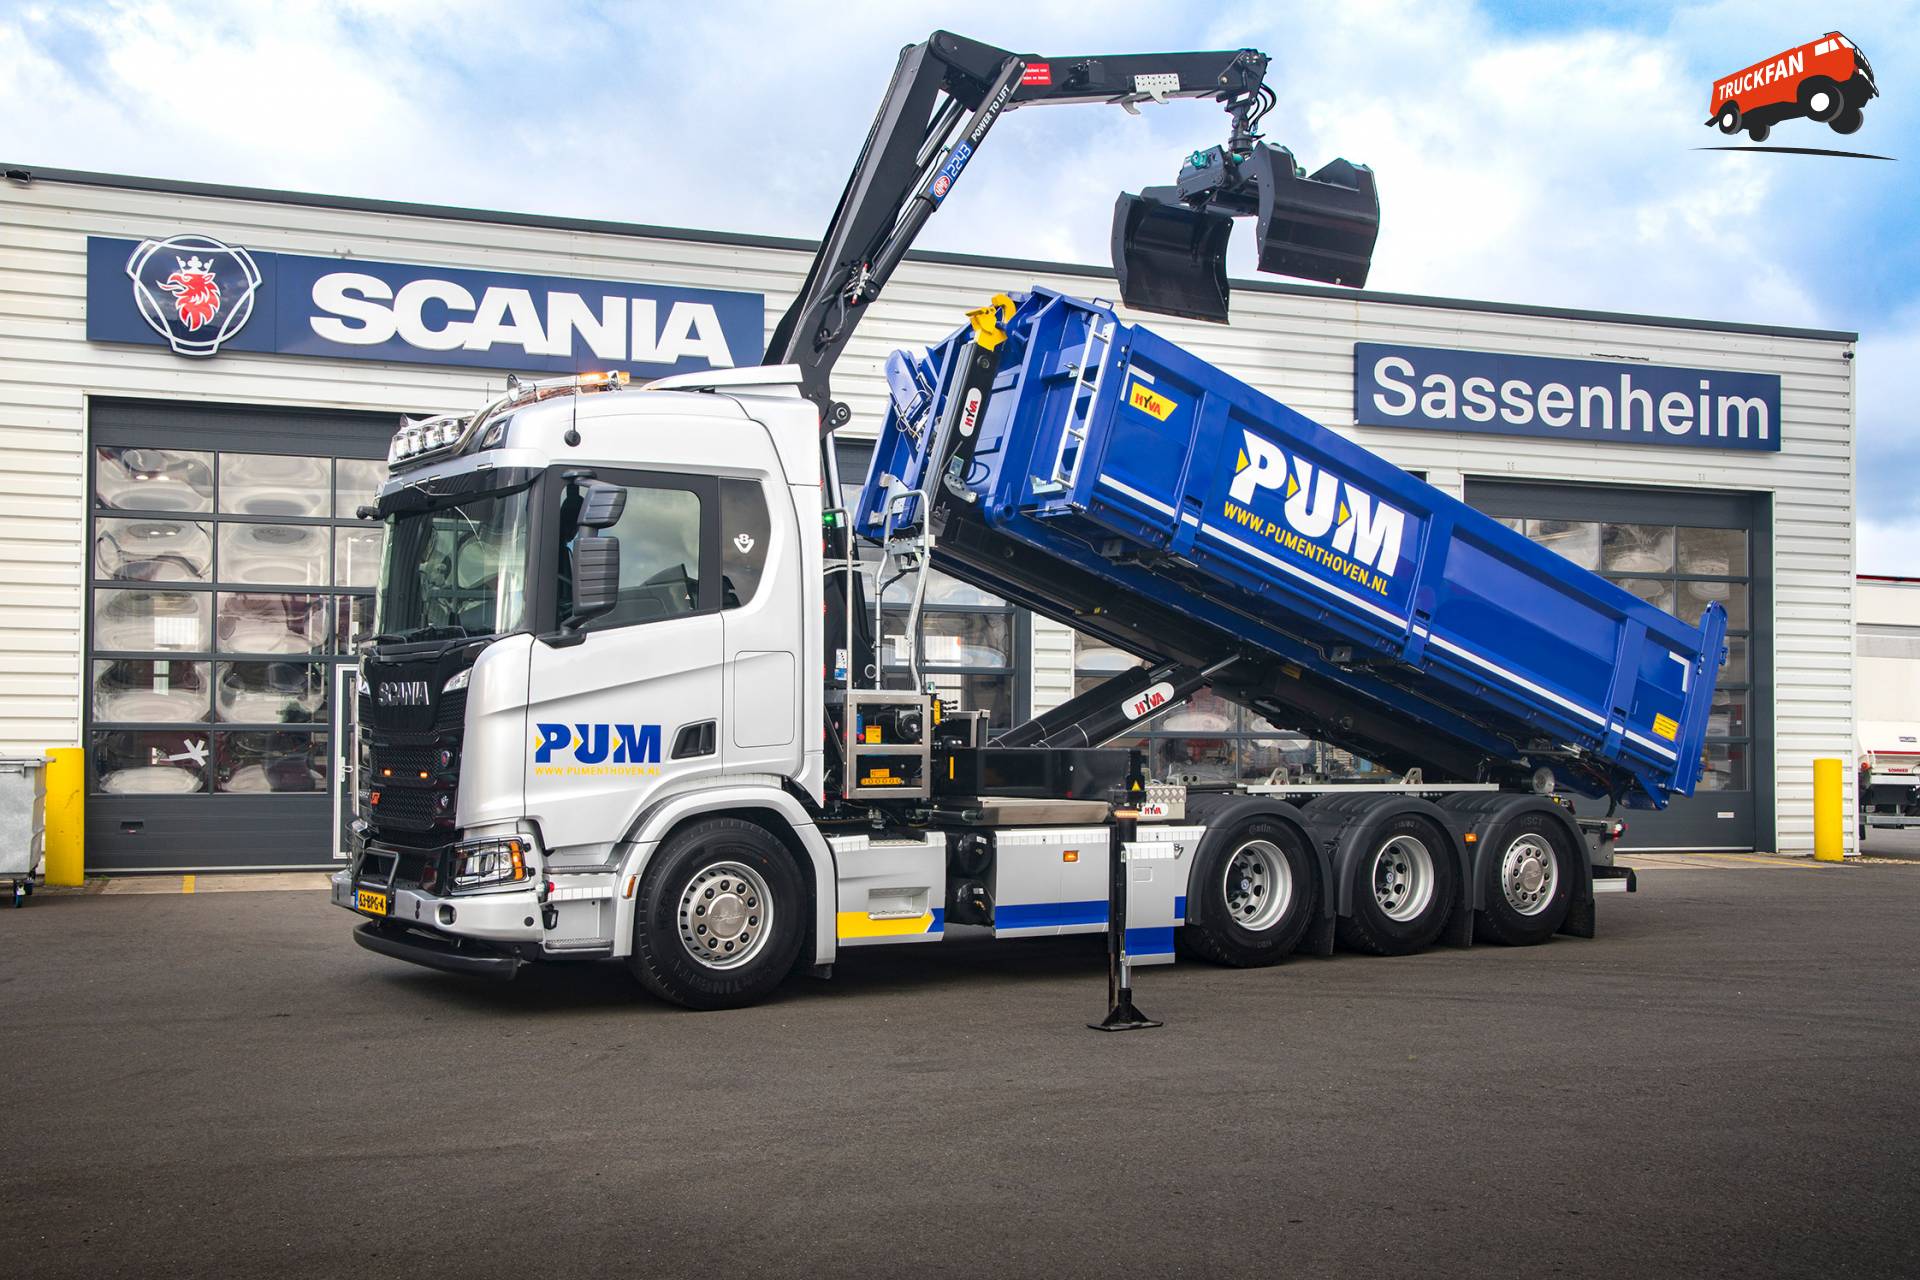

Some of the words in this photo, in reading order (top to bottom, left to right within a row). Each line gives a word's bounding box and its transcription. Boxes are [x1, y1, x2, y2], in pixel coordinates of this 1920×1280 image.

[971, 112, 992, 143] POWER
[989, 100, 1000, 117] TO
[996, 84, 1011, 108] LIFT
[948, 143, 971, 179] 2243
[310, 272, 735, 368] SCANIA
[965, 400, 979, 428] HYVA
[1134, 392, 1162, 416] HYVA
[1373, 356, 1769, 440] Sassenheim
[1228, 428, 1405, 577] PUM
[1223, 500, 1388, 596] WWW.PUMENTHOVEN.NL
[379, 681, 430, 706] SCANIA
[1134, 692, 1165, 715] HYVA
[535, 723, 661, 764] PUM
[1144, 804, 1162, 815] HYVA
